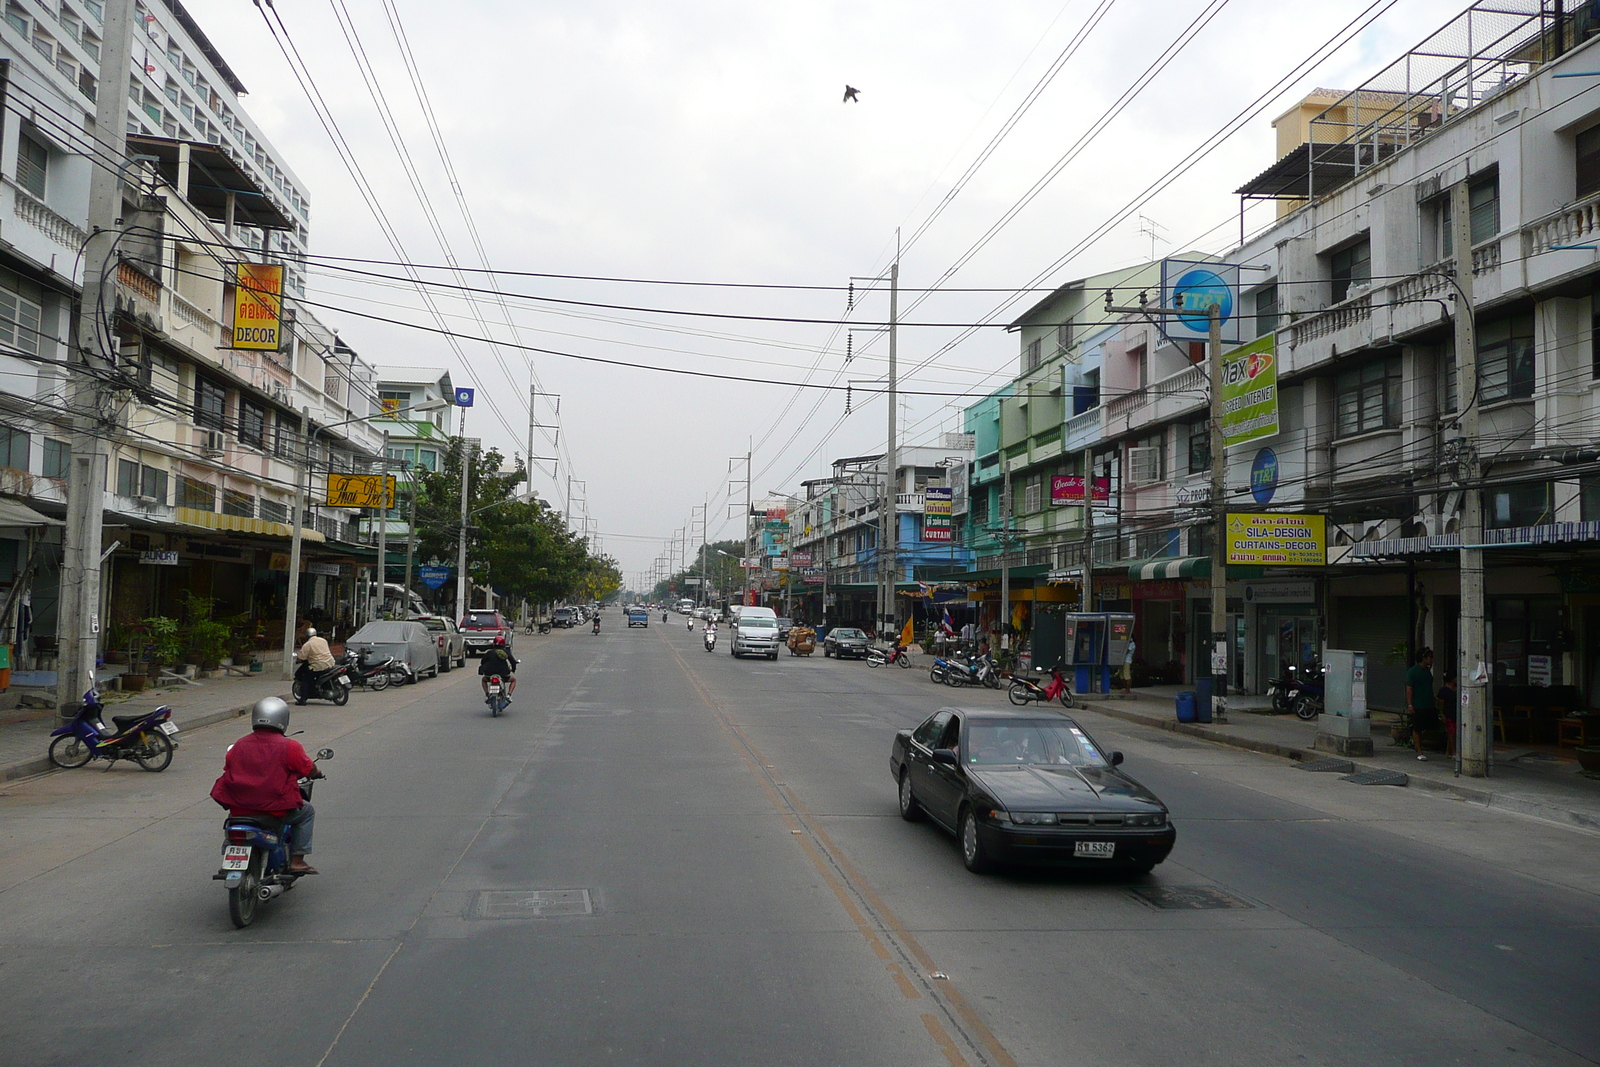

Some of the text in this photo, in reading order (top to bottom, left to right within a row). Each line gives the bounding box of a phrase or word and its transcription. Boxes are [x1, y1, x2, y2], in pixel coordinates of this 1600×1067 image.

[236, 327, 276, 343] DECOR
[1226, 396, 1242, 413] SPEED
[1244, 386, 1274, 408] INTERNET
[1253, 467, 1276, 485] TT&T
[926, 531, 951, 539] CURTAIN
[1246, 527, 1312, 538] SILA-DESIGN
[1234, 541, 1317, 550] CURTAINS-DECOR
[140, 551, 178, 560] LAUNDRY
